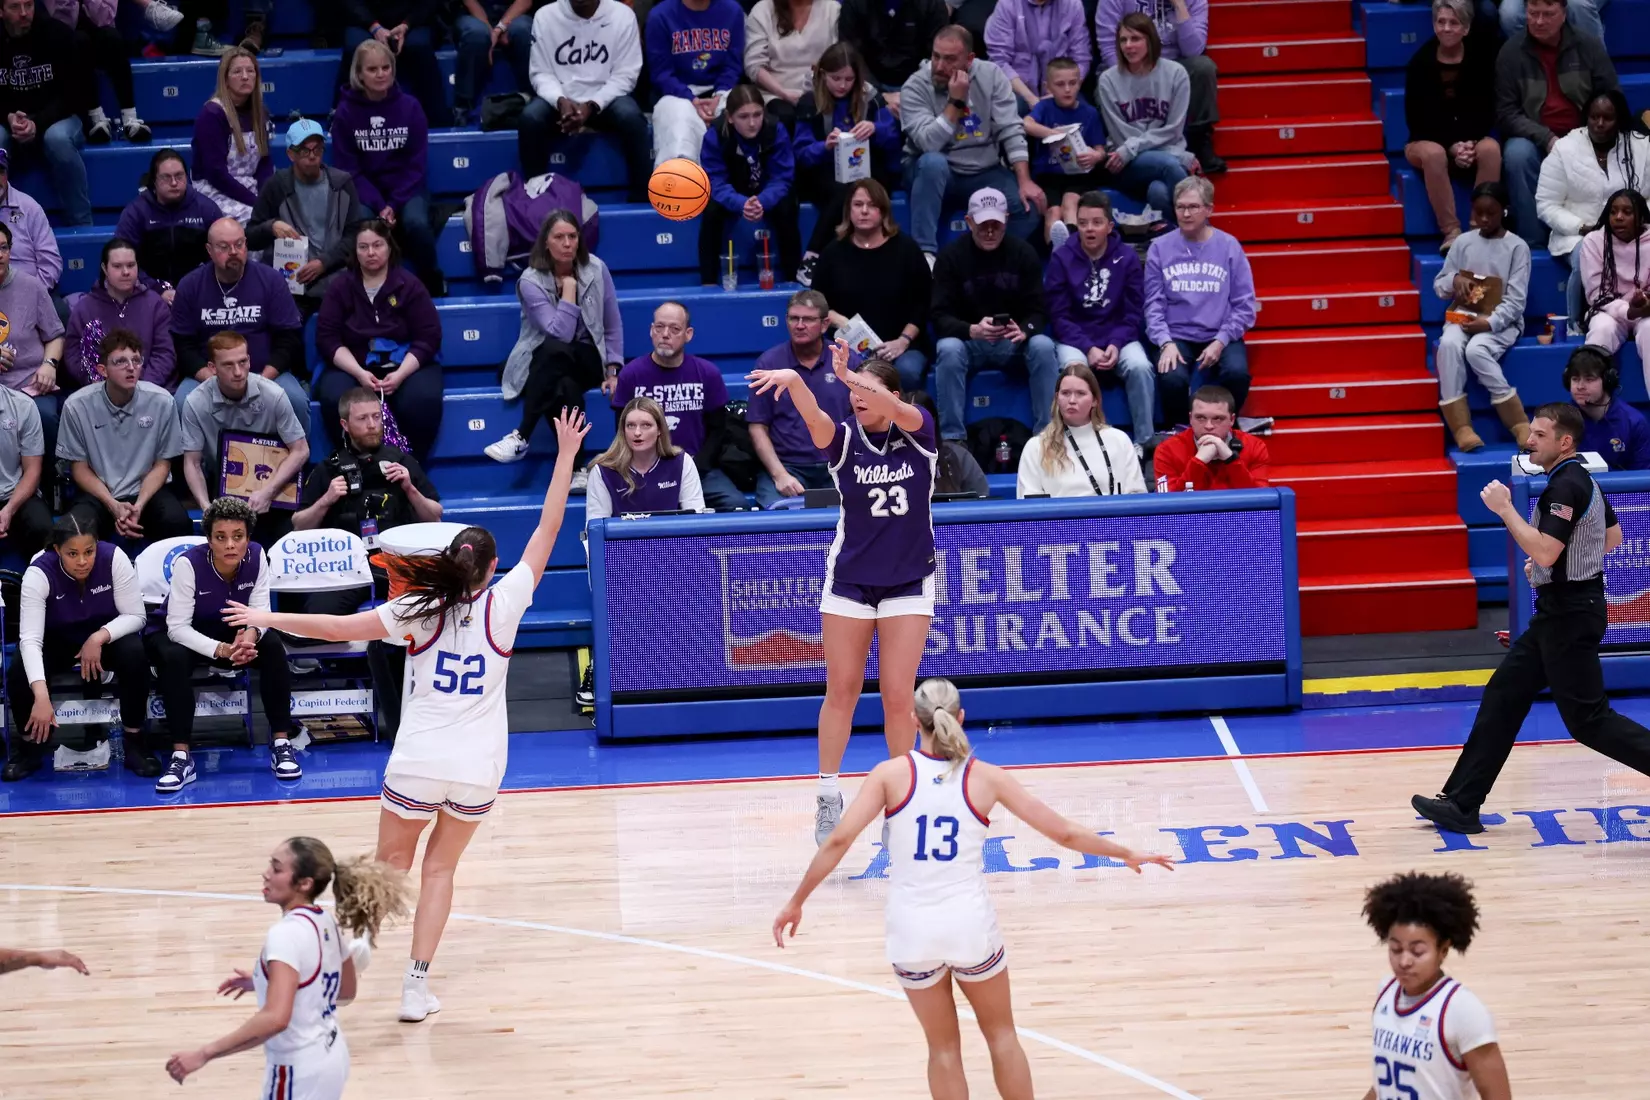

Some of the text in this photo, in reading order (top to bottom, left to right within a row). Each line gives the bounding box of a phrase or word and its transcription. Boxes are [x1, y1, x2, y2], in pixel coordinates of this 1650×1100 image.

[671, 28, 731, 54] KANSAS
[555, 35, 609, 65] Cats
[167, 87, 175, 96] 10
[457, 157, 465, 168] 13
[660, 234, 670, 244] 15
[73, 259, 80, 269] 9
[1162, 262, 1228, 282] KANSAS STATE
[1171, 280, 1221, 293] WILDCATS
[201, 305, 262, 321] K-STATE
[766, 316, 776, 326] 16
[467, 330, 476, 340] 13
[634, 383, 704, 402] K-STATE
[1335, 389, 1341, 399] 2
[665, 399, 703, 413] BASKETBALL
[472, 419, 481, 429] 13
[251, 437, 278, 447] K-STATE
[853, 460, 915, 485] Wildcats
[868, 485, 910, 517] 23
[281, 535, 353, 557] Capitol
[282, 555, 354, 575] Federal
[936, 538, 1183, 606] ELTER
[922, 605, 1182, 655] SURANCE
[433, 650, 485, 695] 52
[210, 698, 244, 708] Federal
[298, 697, 368, 708] Capitol Federal
[914, 814, 960, 861] 13
